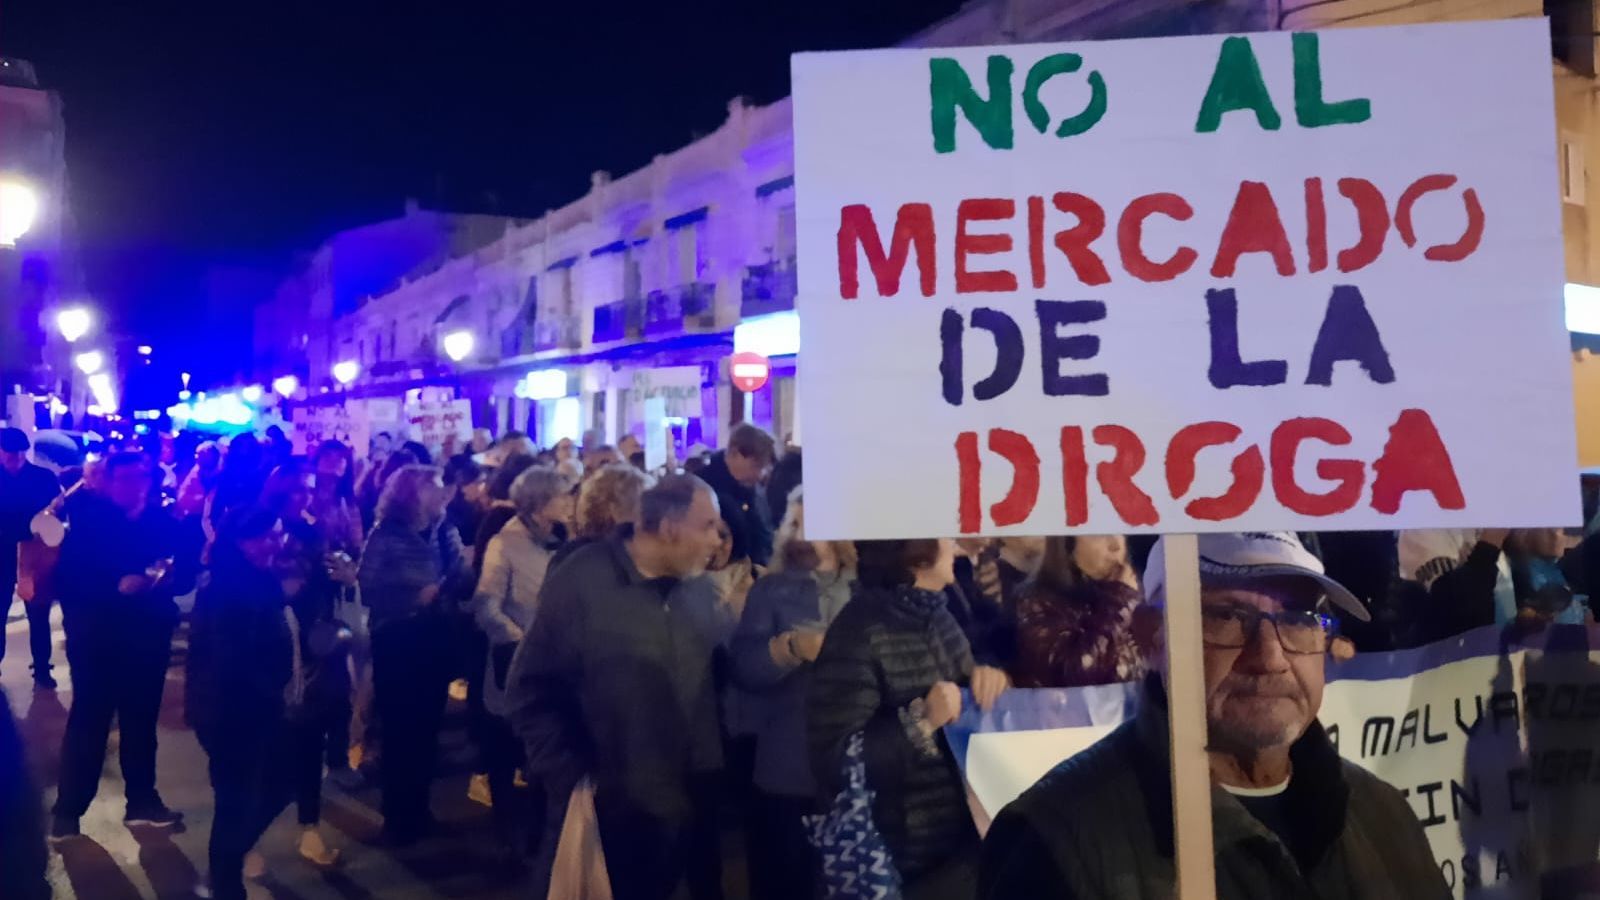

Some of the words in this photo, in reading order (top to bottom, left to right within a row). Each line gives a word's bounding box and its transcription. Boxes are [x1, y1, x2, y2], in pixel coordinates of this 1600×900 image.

[929, 53, 1107, 154] NO
[1195, 32, 1372, 133] AL
[836, 173, 1485, 300] MERCADO
[939, 298, 1110, 405] DE
[1205, 284, 1396, 390] LA
[955, 408, 1466, 534] DROGA
